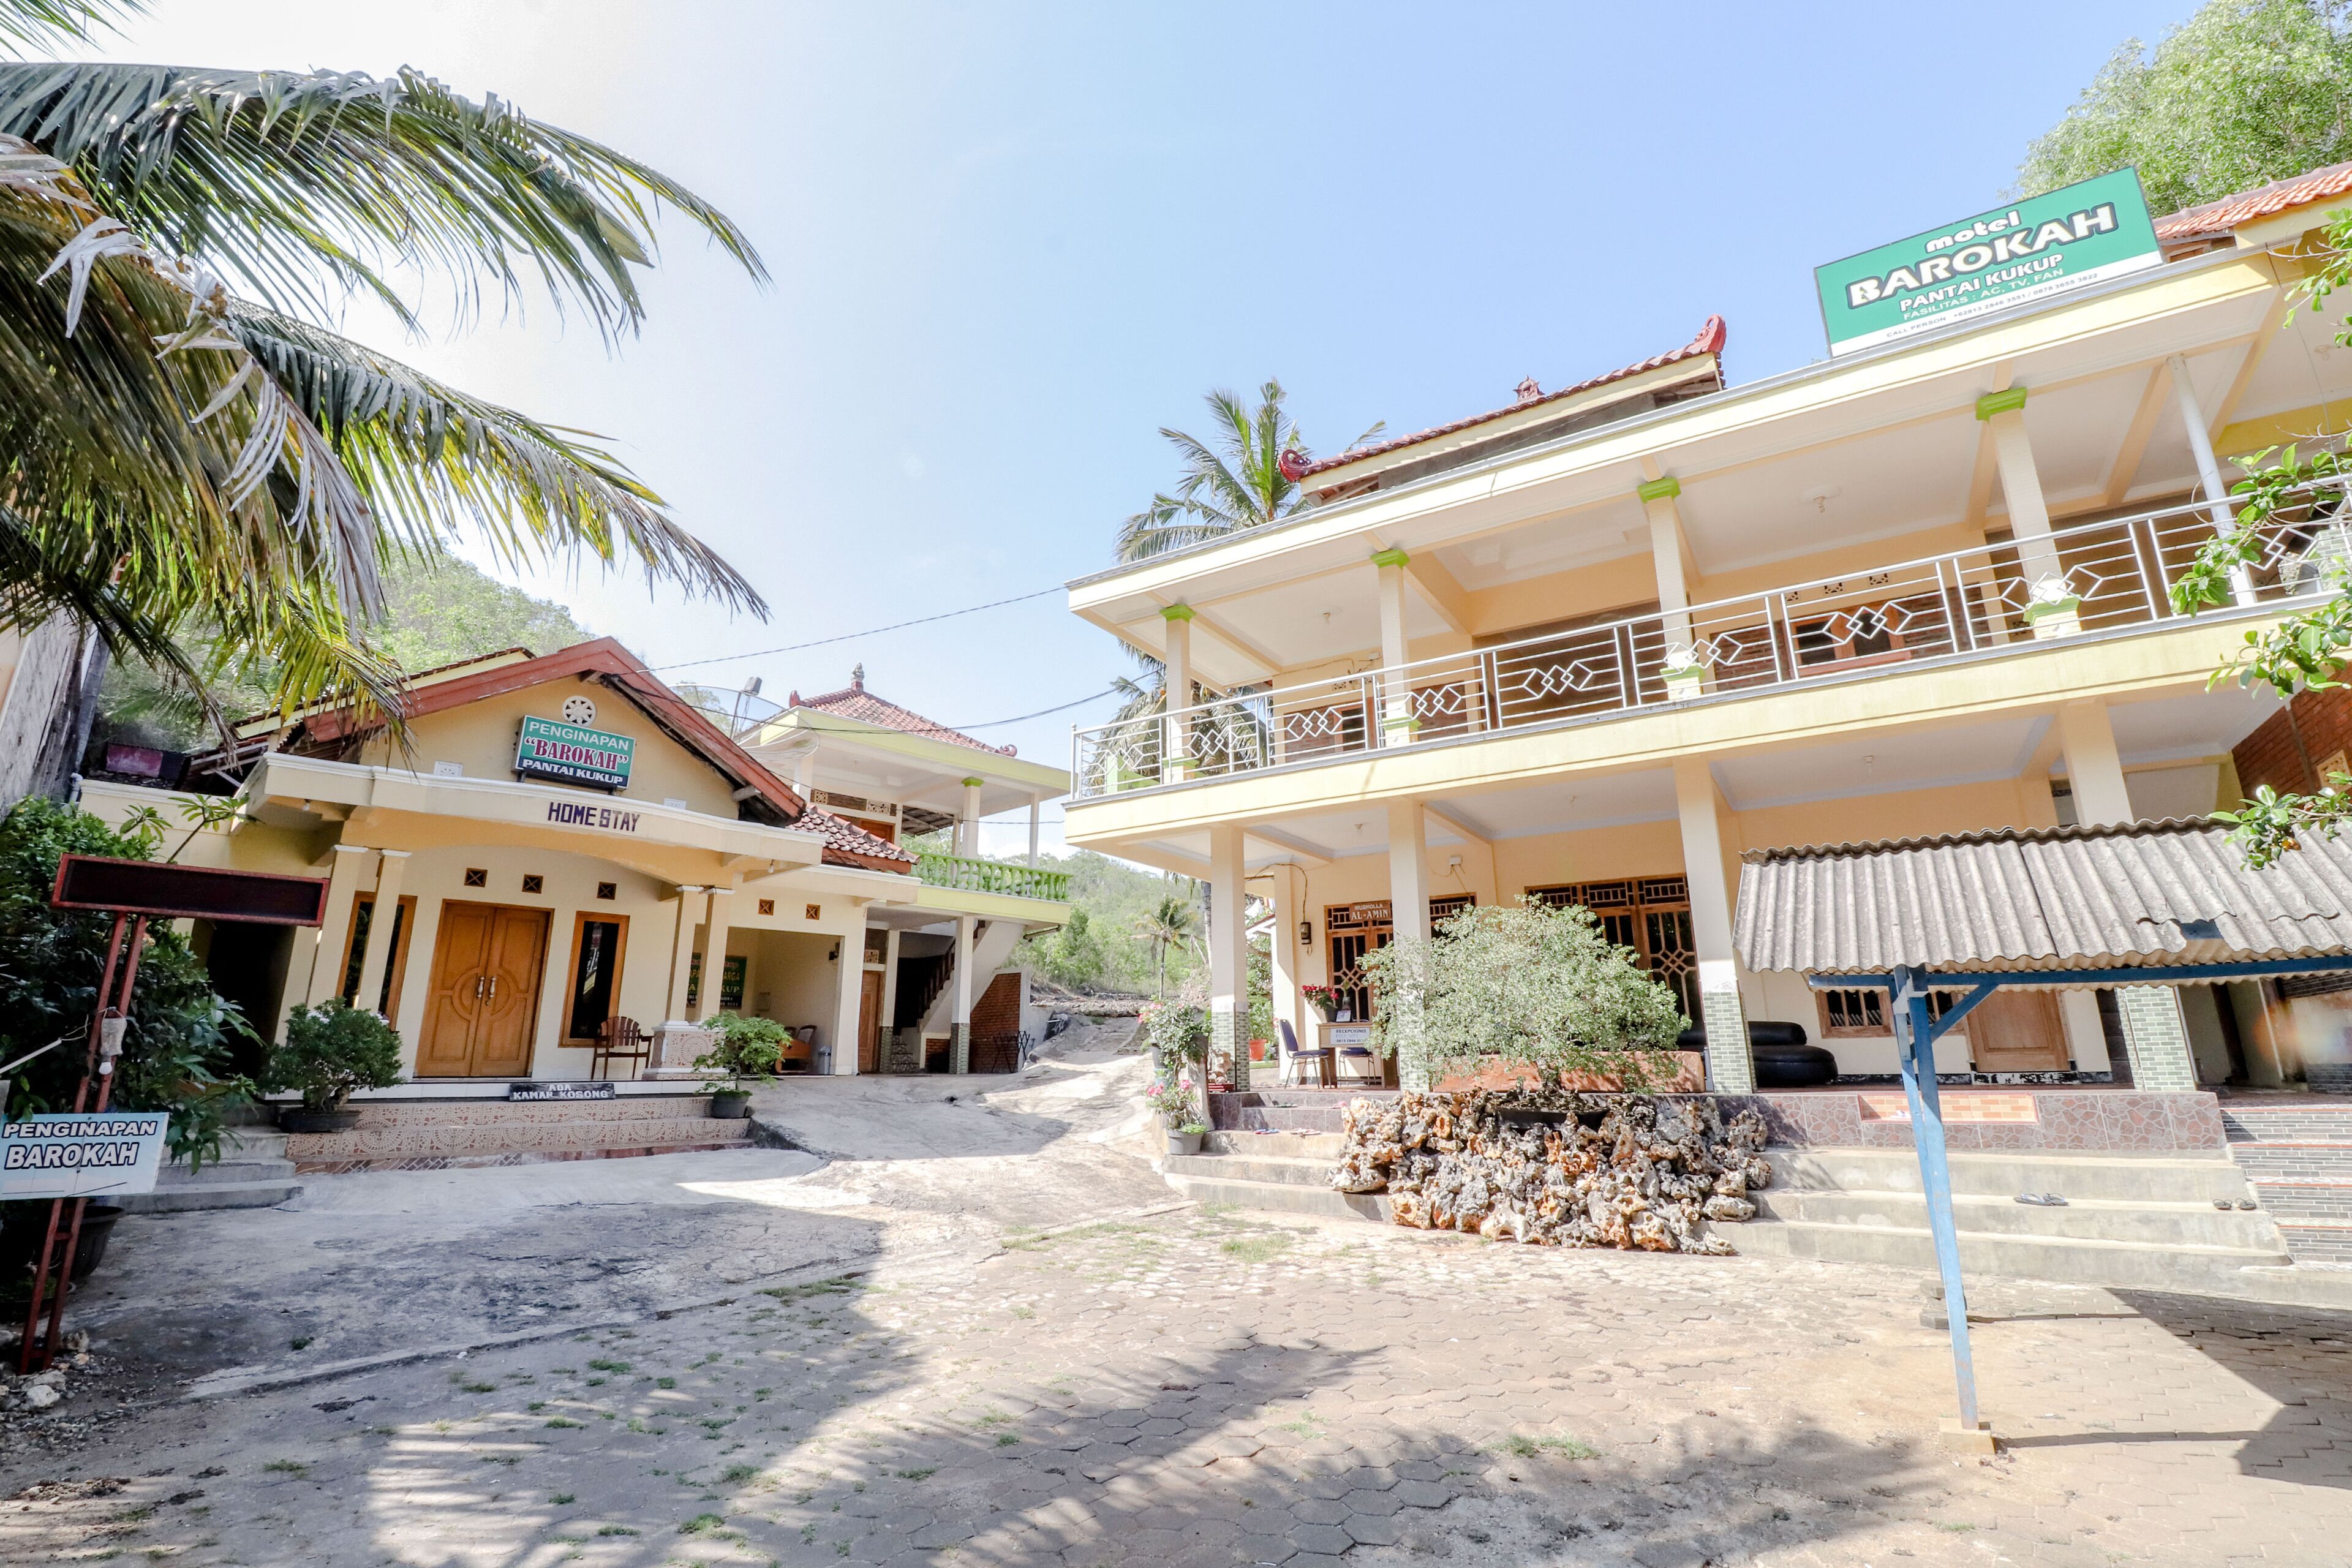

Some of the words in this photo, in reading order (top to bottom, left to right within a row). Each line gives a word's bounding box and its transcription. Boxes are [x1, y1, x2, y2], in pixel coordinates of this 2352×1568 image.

[1926, 209, 2021, 254] motel
[1846, 202, 2118, 309] BAROKAH
[1899, 277, 1981, 312] PANTAI
[1985, 253, 2064, 287] KUKUP
[1903, 296, 1968, 320] FASILITAS
[2034, 268, 2064, 282] FAN
[1887, 329, 1909, 337] CALL
[1911, 317, 1946, 330] PERSON
[2006, 294, 2026, 303] 3551
[2078, 273, 2098, 282] 3822
[529, 721, 629, 751] PENGINAPAN
[522, 759, 574, 776] PANTAI
[576, 767, 623, 784] KUKUP
[548, 802, 597, 826] HOME
[599, 809, 641, 832] STAY
[513, 1091, 554, 1100] KAMAR
[2, 1121, 158, 1139] PENGINAPAN
[4, 1142, 140, 1170] BAROKAH
